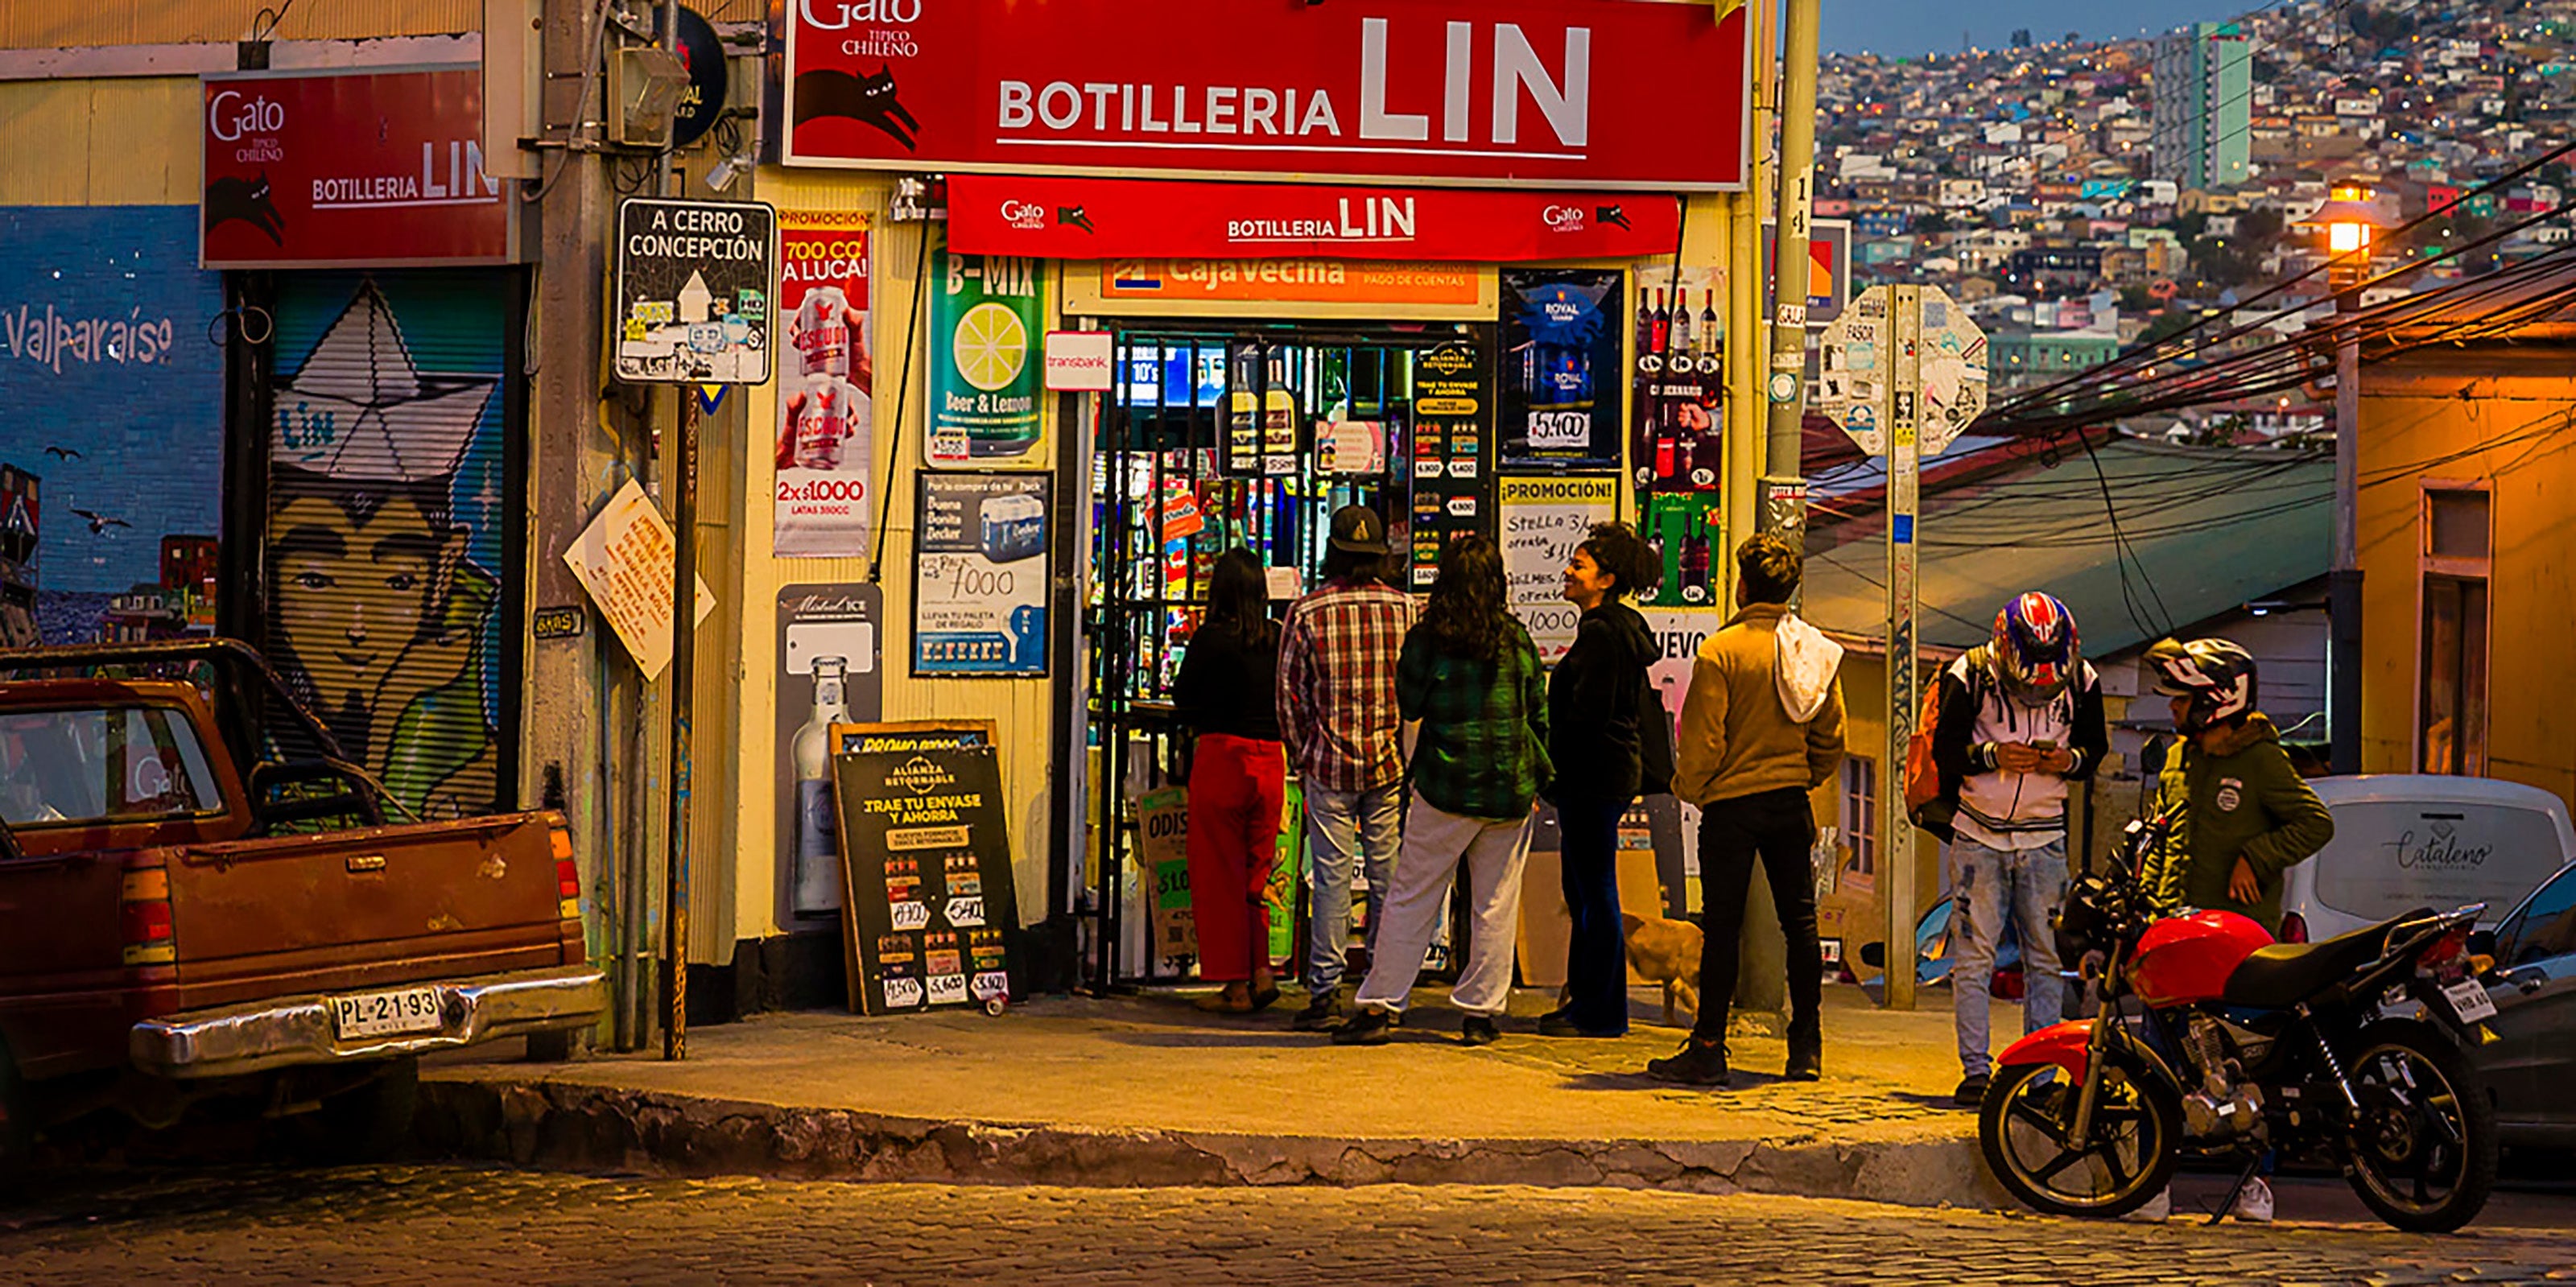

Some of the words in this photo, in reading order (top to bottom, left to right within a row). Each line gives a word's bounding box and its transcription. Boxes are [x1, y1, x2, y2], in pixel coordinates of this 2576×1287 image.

[841, 39, 919, 57] CHILENO
[999, 80, 1342, 137] BOTILLERIA
[1360, 17, 1590, 146] LIN
[210, 90, 283, 141] Gato
[237, 149, 283, 162] CHILENO
[312, 177, 418, 200] BOTILLERIA
[423, 140, 498, 197] LIN
[1001, 200, 1044, 221] Gato
[1228, 220, 1335, 237] BOTILLERIA
[1339, 197, 1415, 237] LIN
[1543, 205, 1583, 225] Gato
[651, 209, 667, 231] A
[675, 209, 743, 233] CERRO
[629, 234, 762, 262] CONCEPCIÓN
[786, 241, 826, 260] 700
[830, 241, 861, 259] CC
[782, 262, 798, 281] A
[803, 258, 867, 280] LUCA!
[947, 254, 1035, 297] B-MIX
[1364, 275, 1394, 285] PAGO
[1397, 276, 1411, 286] DE
[1414, 276, 1465, 287] CUENTAS
[1546, 303, 1579, 315] ROYAL
[945, 390, 975, 411] Beer
[977, 394, 989, 413] &
[992, 394, 1032, 413] Lemon
[954, 483, 988, 493] compra
[1502, 481, 1612, 501] ¡PROMOCIÓN!
[847, 600, 866, 611] ICE
[949, 621, 984, 629] REGALO
[893, 765, 944, 776] ALIANZA
[864, 798, 902, 812] TRAE
[904, 798, 924, 810] TU
[927, 794, 981, 809] ENVASE
[890, 813, 899, 824] Y
[902, 809, 958, 823] AHORRA
[2380, 831, 2493, 868] Cataleno
